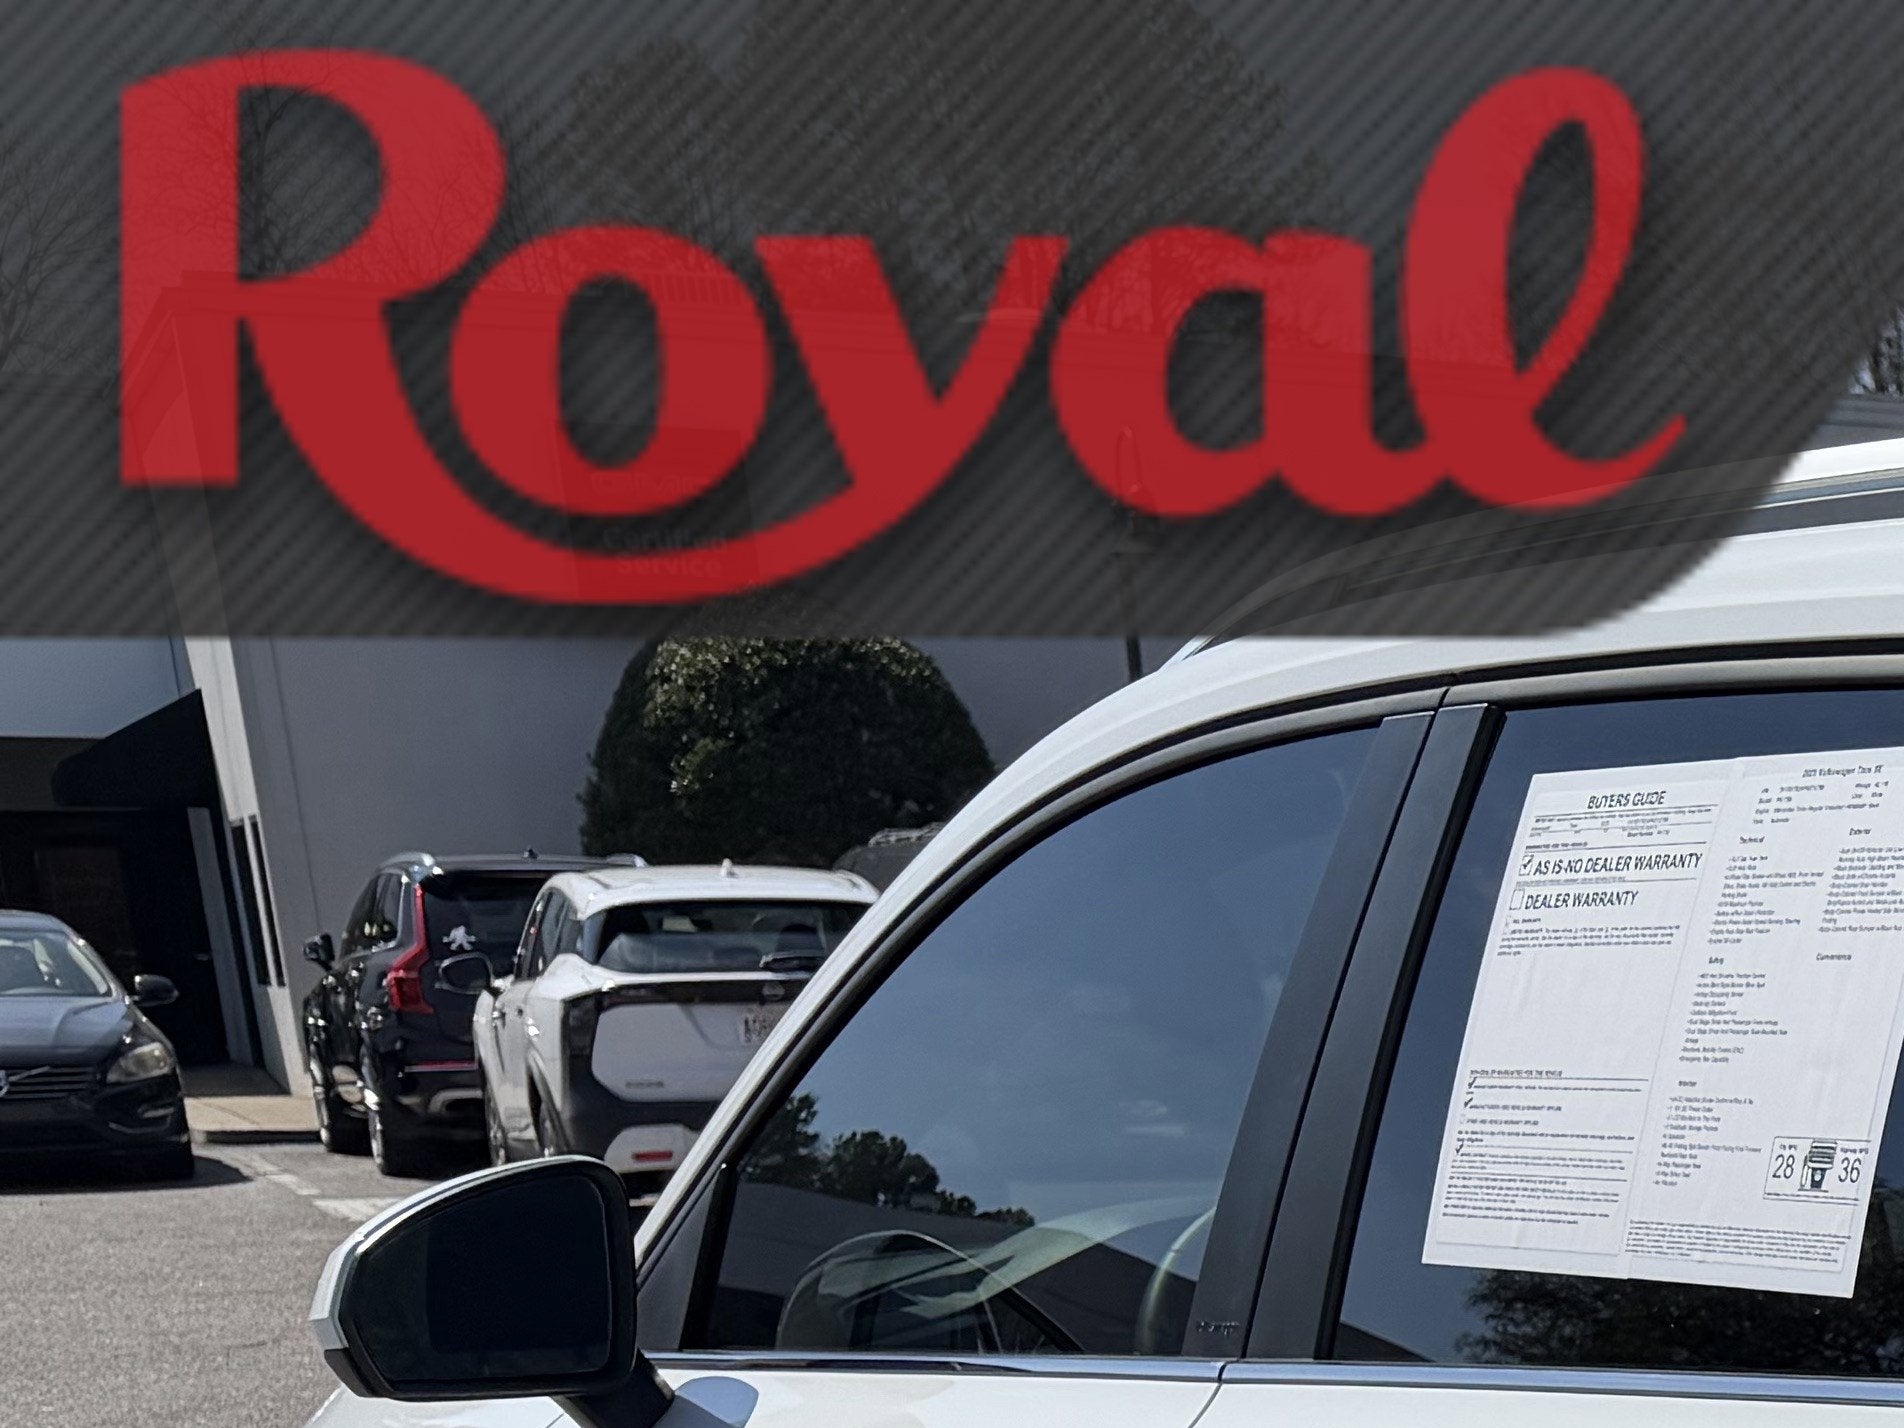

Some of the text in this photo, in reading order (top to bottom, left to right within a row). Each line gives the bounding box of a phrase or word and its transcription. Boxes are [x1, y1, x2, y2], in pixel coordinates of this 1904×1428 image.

[1587, 790, 1667, 809] BUYERS GUIDE
[1533, 858, 1550, 876] AS
[1584, 855, 1632, 873] DEALER
[1634, 852, 1703, 872] WARRANTY
[1524, 890, 1639, 911] DEALER WARRANTY
[1772, 1153, 1796, 1180] 28
[1838, 1156, 1862, 1184] 36
